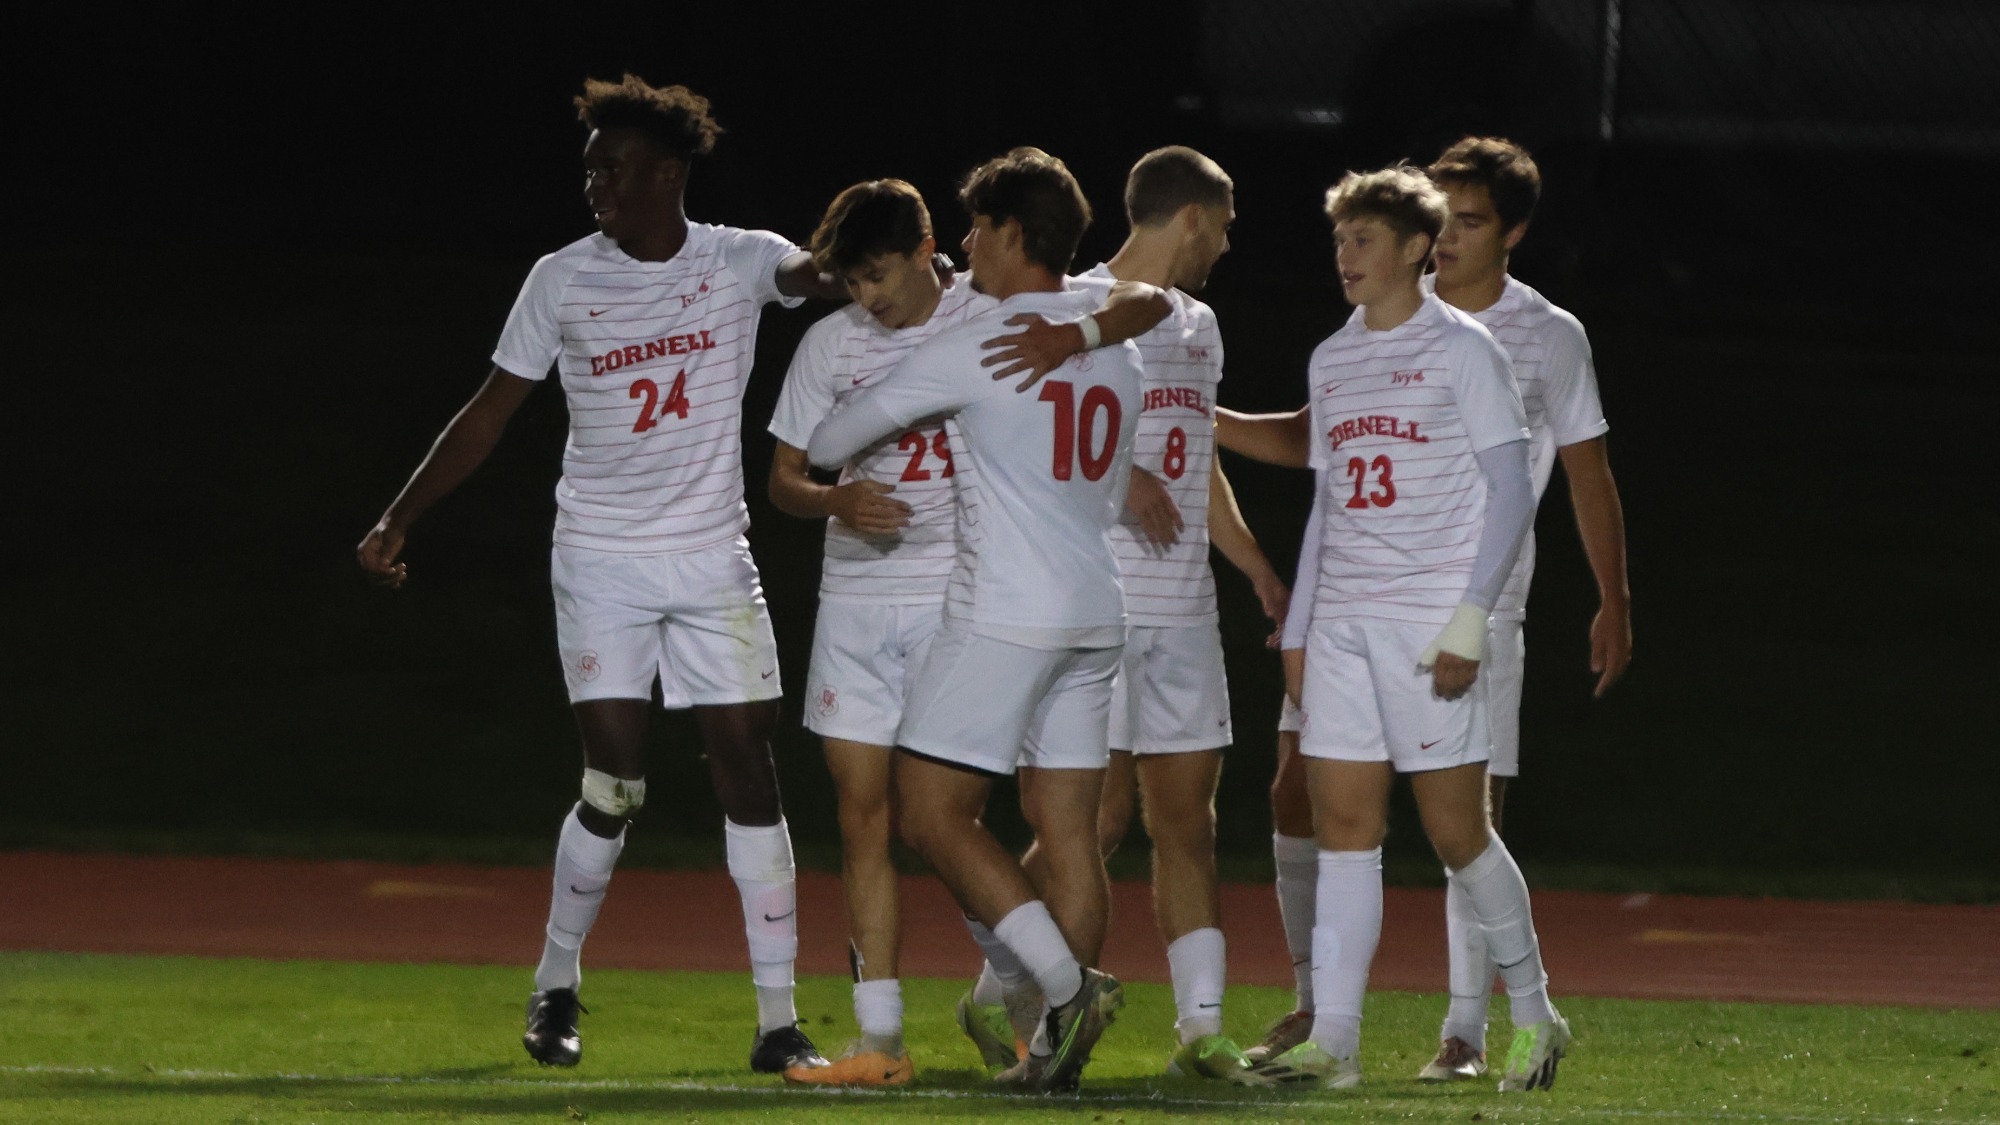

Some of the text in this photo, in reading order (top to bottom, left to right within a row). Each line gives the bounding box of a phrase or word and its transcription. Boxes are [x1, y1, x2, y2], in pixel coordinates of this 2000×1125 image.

[591, 330, 716, 376] CORNELL
[1391, 371, 1413, 386] Ivy
[629, 368, 690, 433] 24
[1038, 380, 1121, 482] 10
[1163, 426, 1186, 480] 8
[1345, 454, 1397, 509] 23
